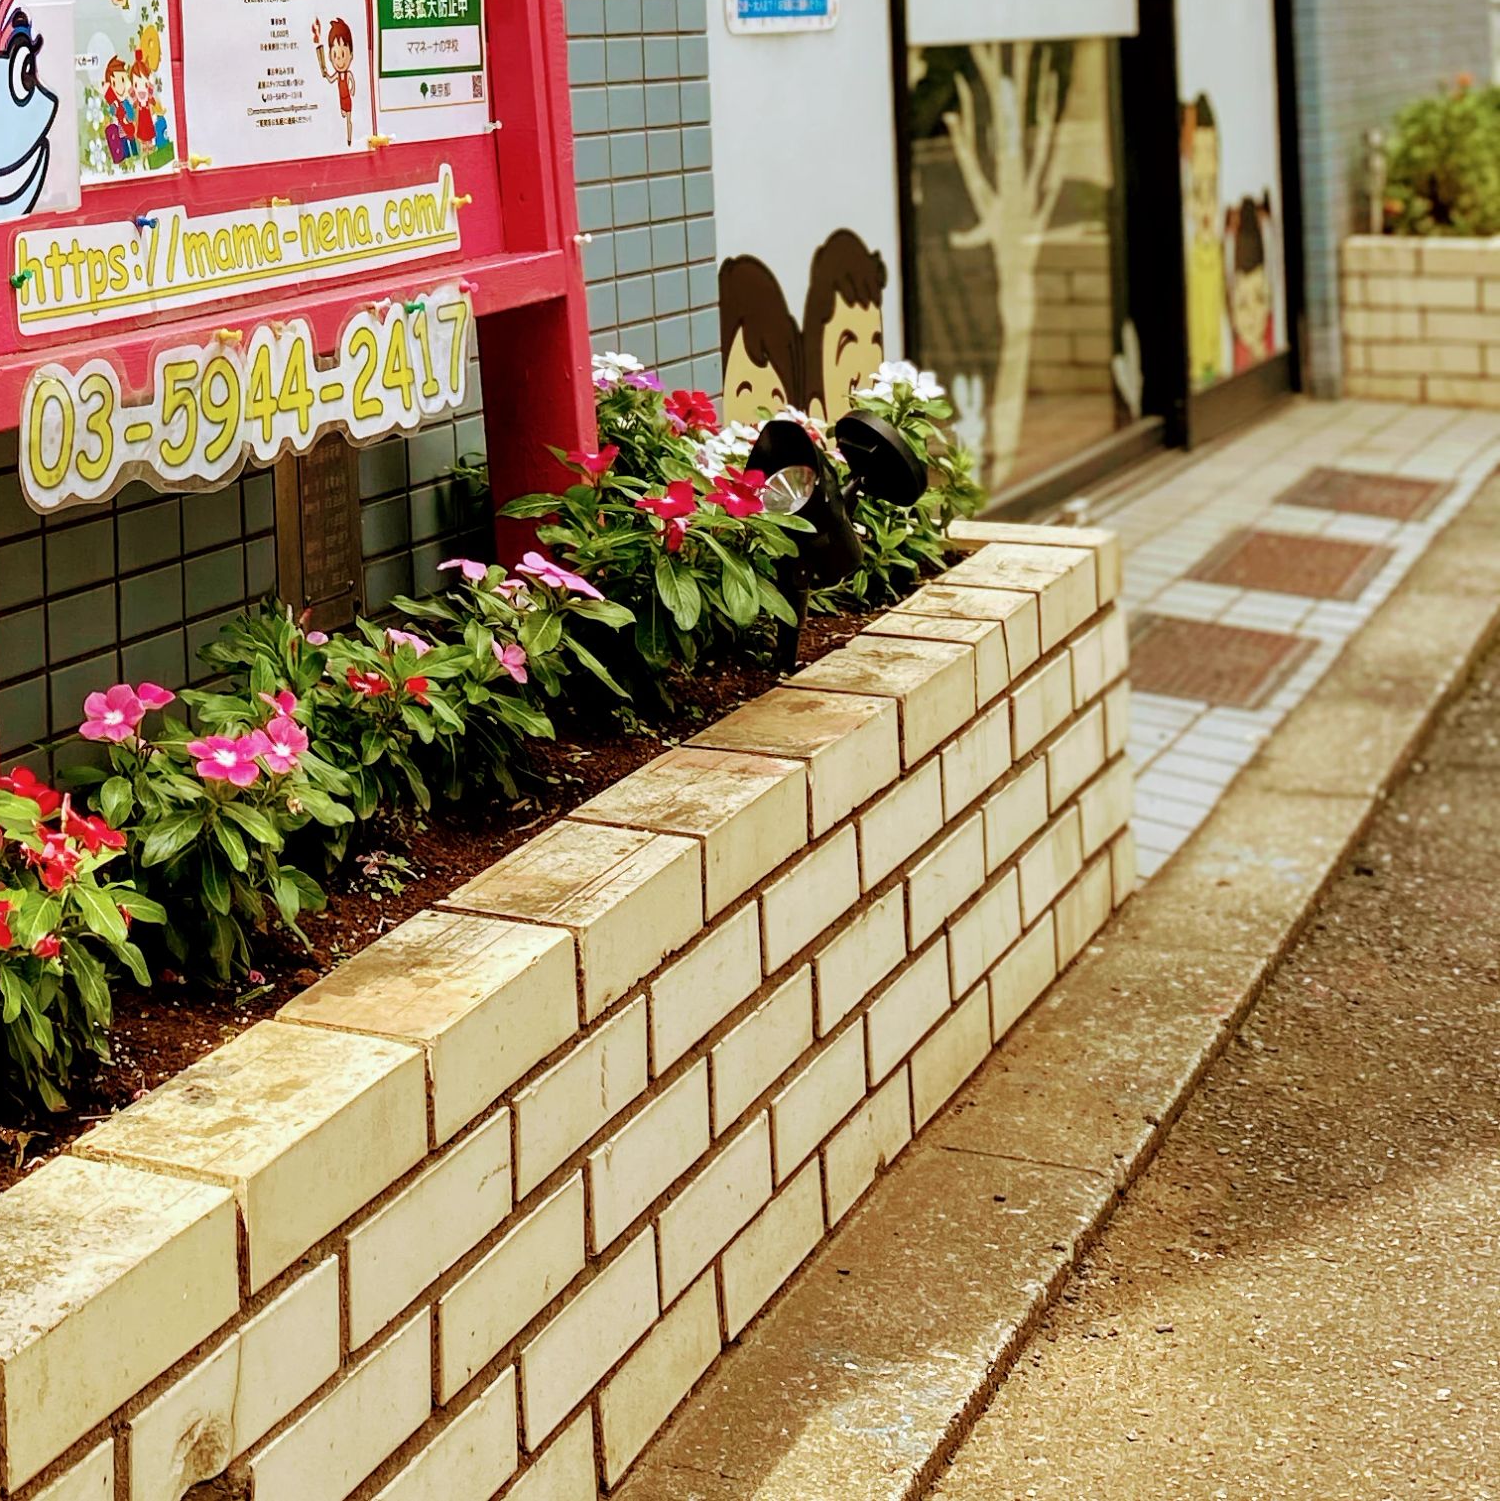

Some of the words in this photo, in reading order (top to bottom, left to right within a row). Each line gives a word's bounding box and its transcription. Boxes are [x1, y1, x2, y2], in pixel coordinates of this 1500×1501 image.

[406, 39, 459, 54] ママネーナの学校
[19, 173, 451, 302] https://mama-nena.com/
[29, 301, 467, 489] 03-5944-2417
